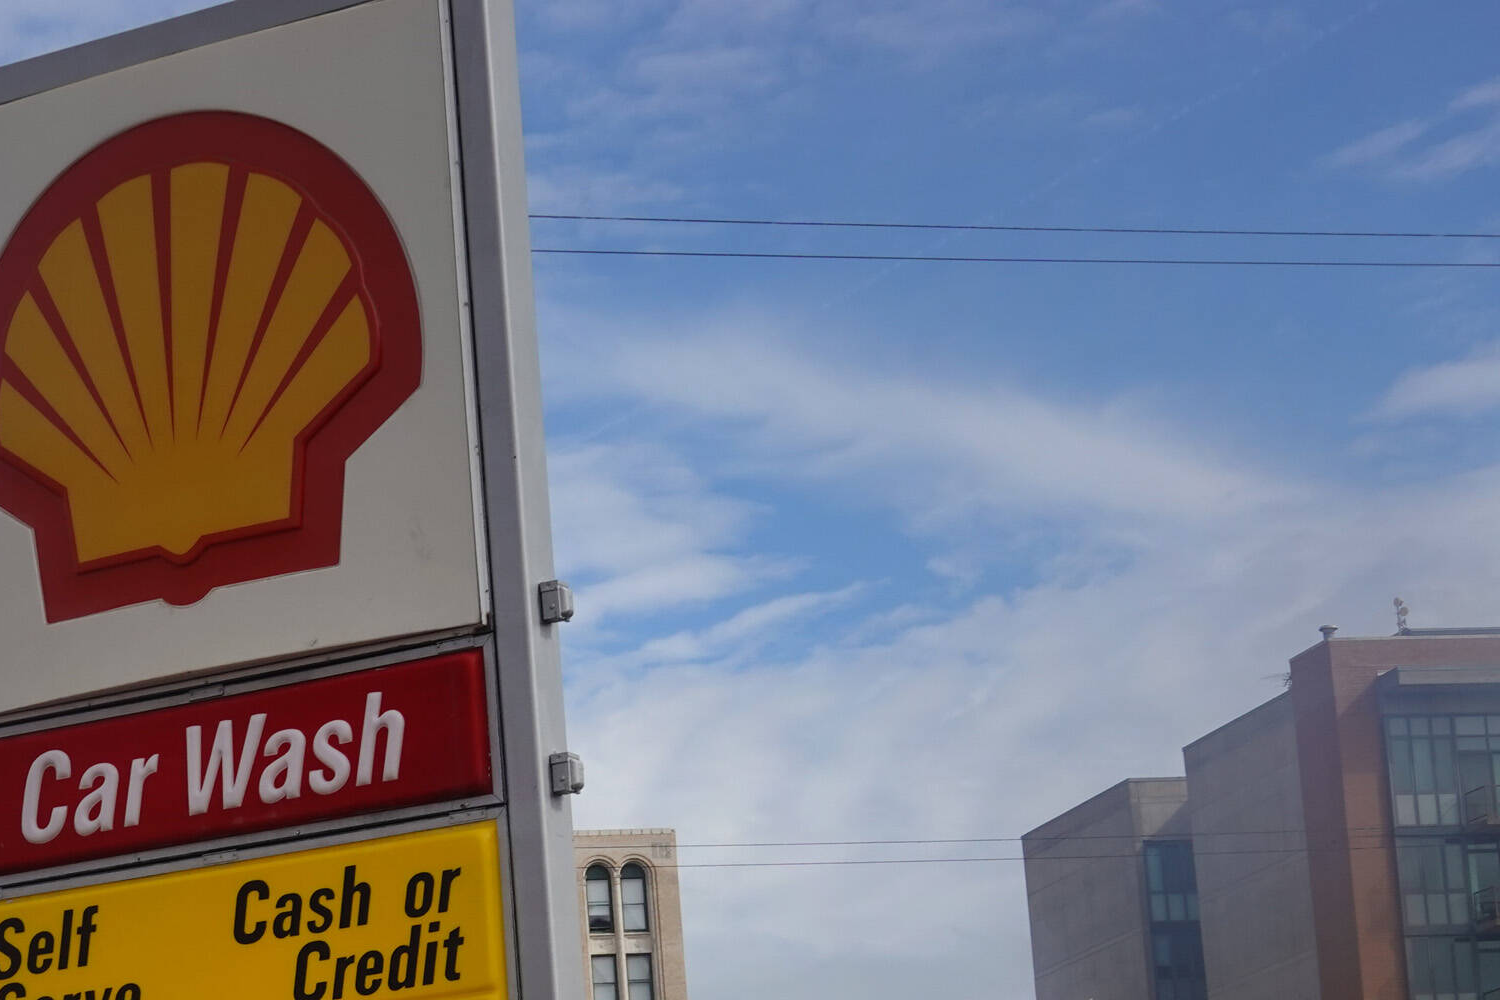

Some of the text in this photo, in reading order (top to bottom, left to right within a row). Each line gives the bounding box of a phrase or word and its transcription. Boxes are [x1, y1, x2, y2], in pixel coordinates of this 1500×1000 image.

[21, 691, 405, 844] Car Wash
[233, 864, 462, 945] Cash or
